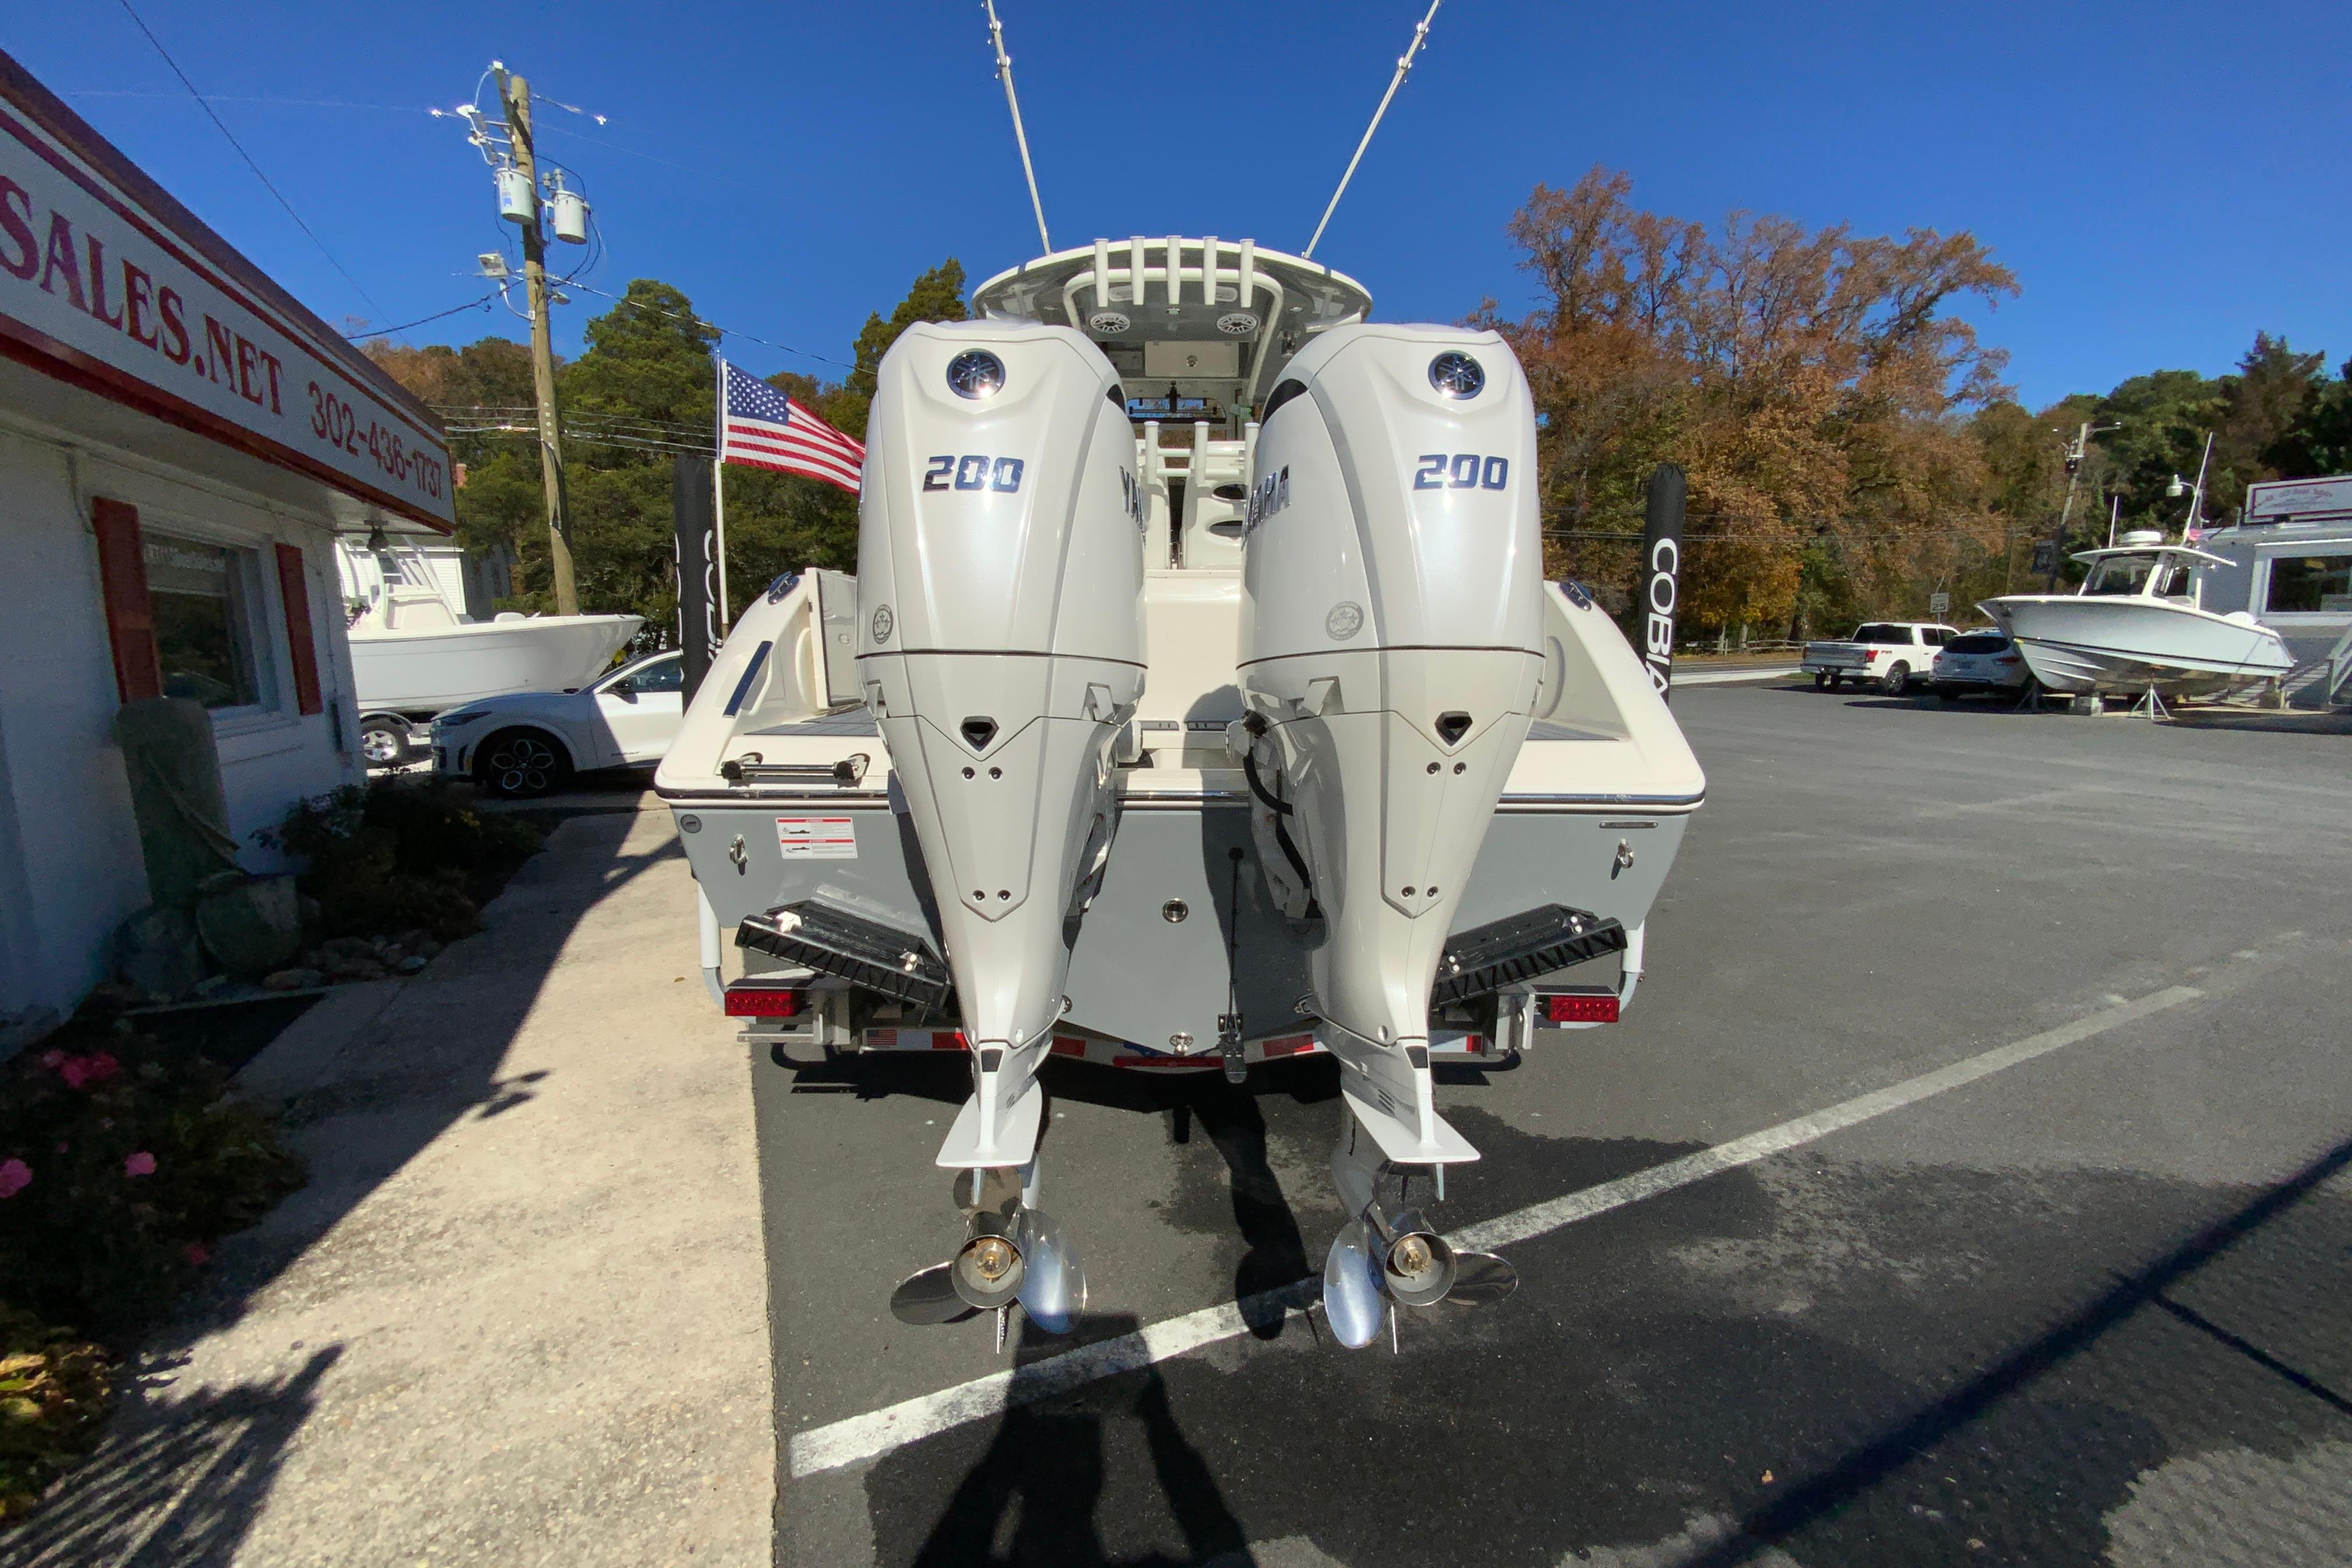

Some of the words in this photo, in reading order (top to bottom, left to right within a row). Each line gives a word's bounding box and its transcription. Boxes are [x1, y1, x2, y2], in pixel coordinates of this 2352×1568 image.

[0, 175, 283, 415] SALES.NET
[308, 381, 442, 499] 302-436-1737
[923, 455, 1024, 494] 200
[1413, 454, 1508, 492] 200
[1645, 538, 1678, 695] COBIA
[1932, 603, 1947, 611] 25
